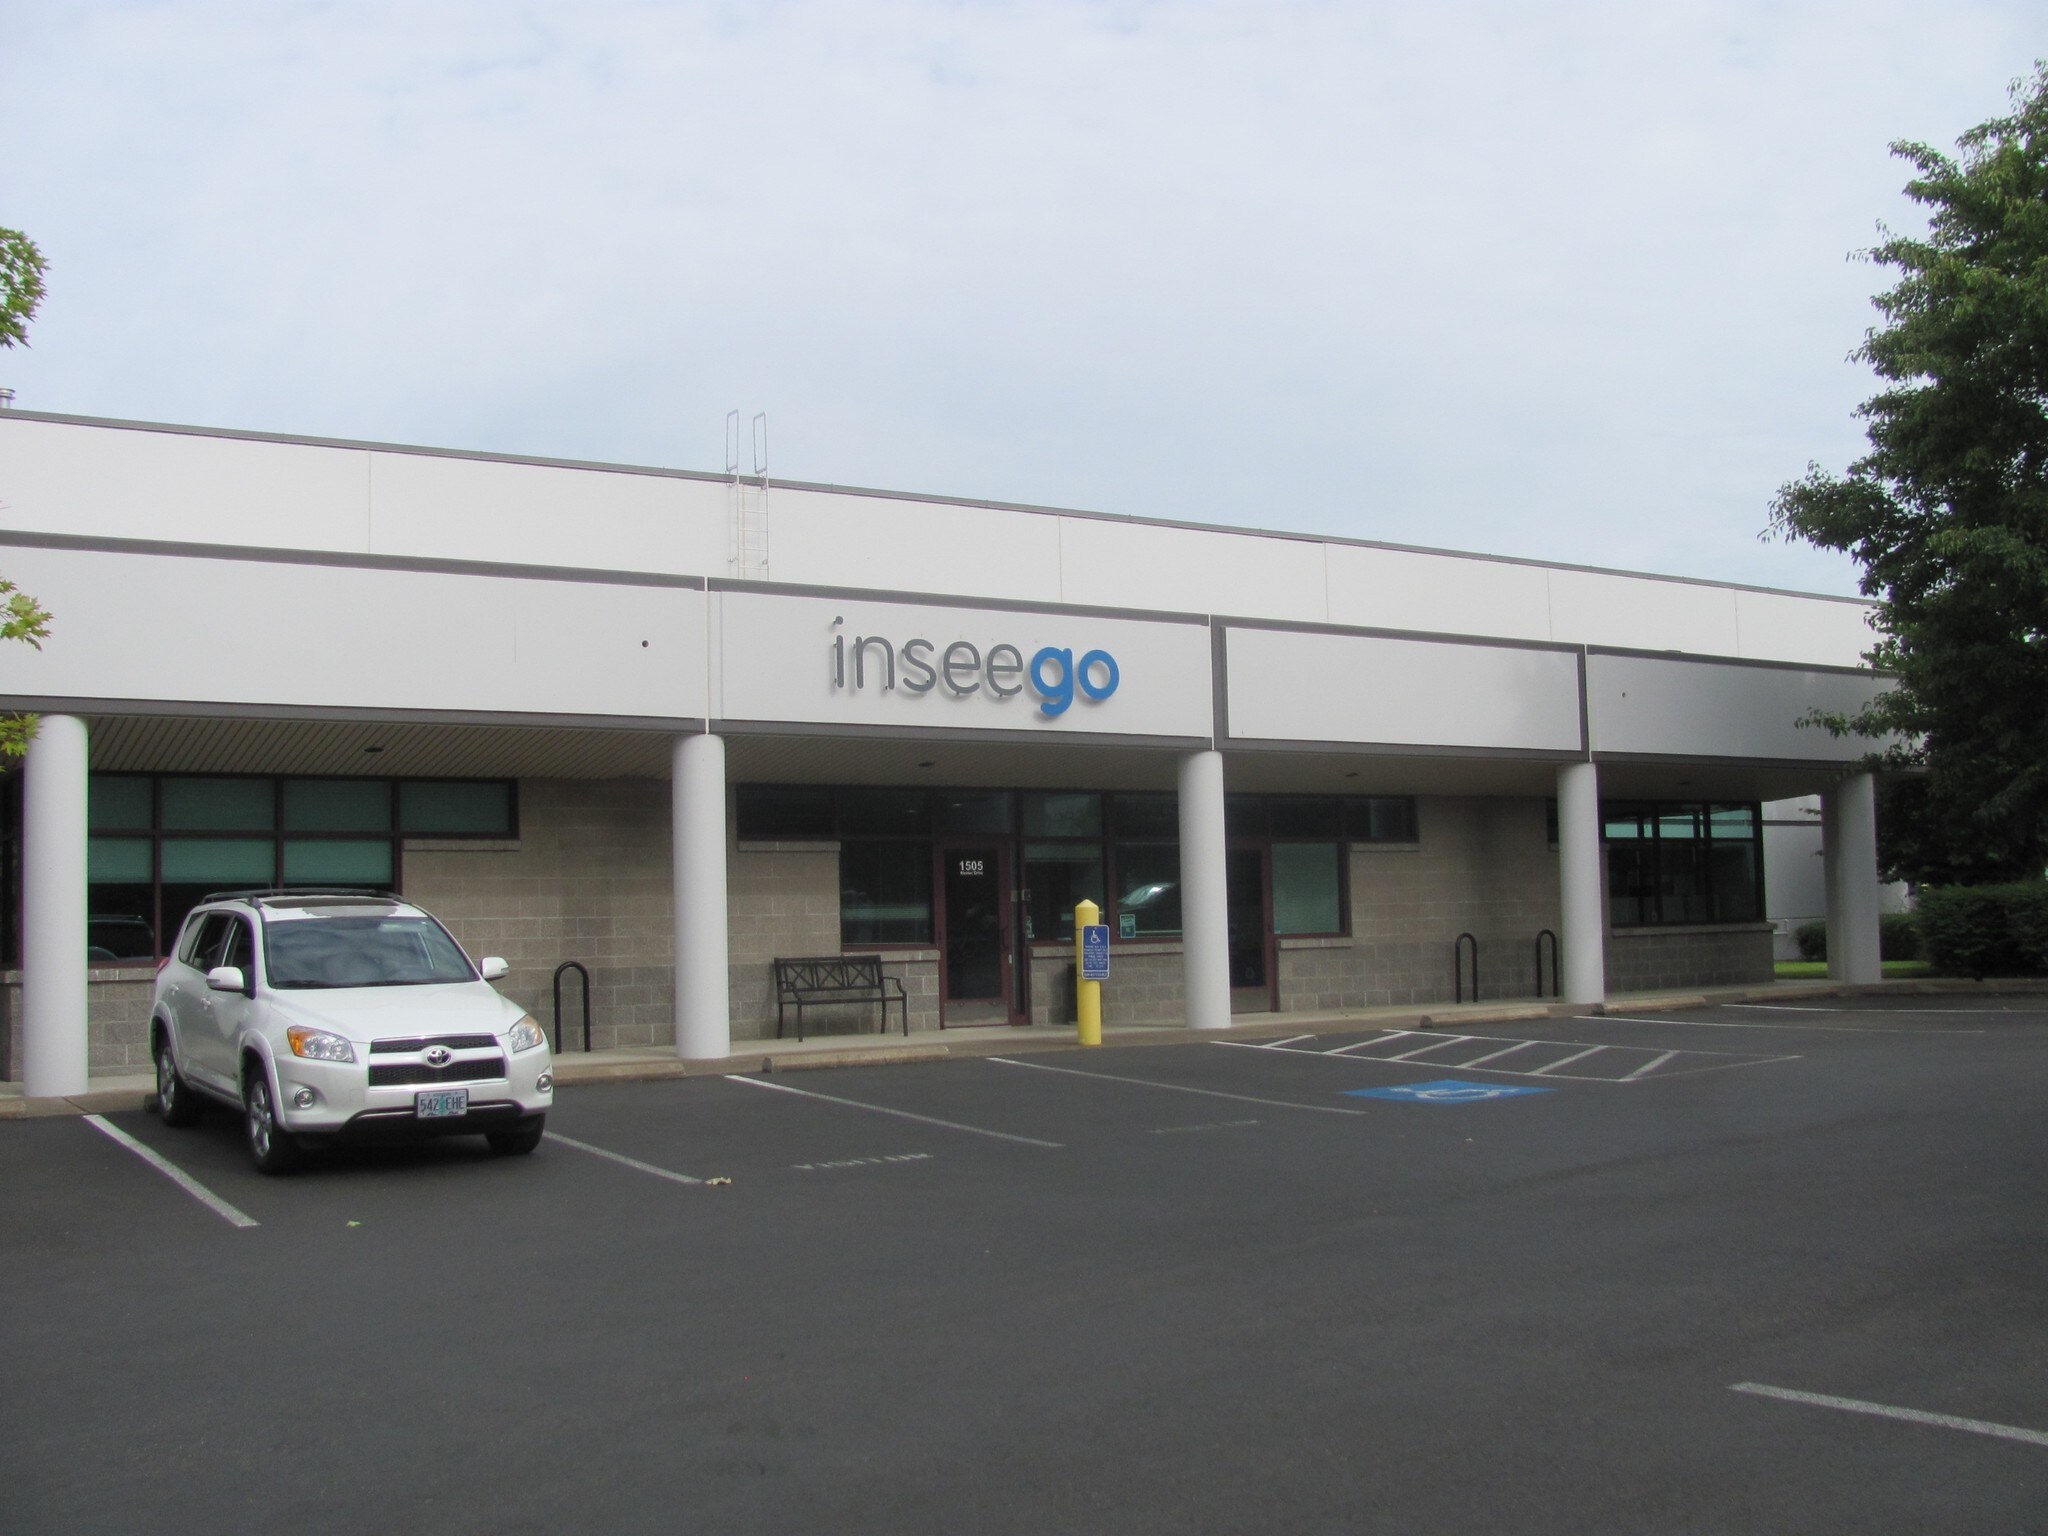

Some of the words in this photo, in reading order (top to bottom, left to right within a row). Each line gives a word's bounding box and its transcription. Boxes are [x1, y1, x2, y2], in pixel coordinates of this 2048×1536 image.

[834, 616, 1120, 716] inseego
[959, 860, 983, 871] 1505
[419, 1097, 440, 1112] 542
[445, 1095, 465, 1110] EHE
